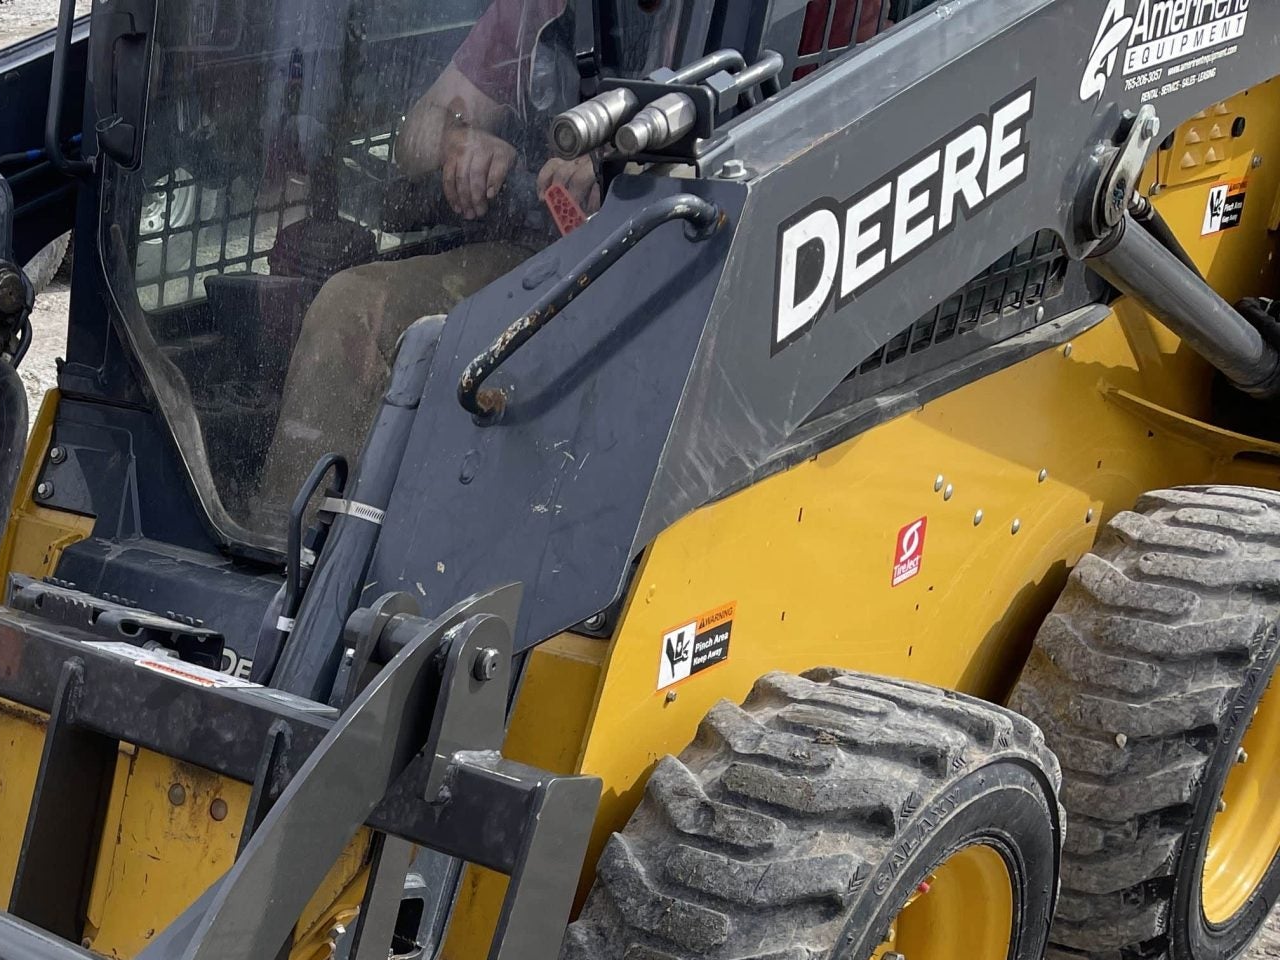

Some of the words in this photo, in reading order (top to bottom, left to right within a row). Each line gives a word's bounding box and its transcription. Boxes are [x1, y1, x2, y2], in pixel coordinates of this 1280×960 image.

[1127, 0, 1250, 47] AmeriRe
[1126, 16, 1244, 70] EQUIPMENT
[1160, 80, 1180, 96] SERVICE
[777, 91, 1032, 343] DEERE
[705, 607, 733, 626] WARNING
[693, 654, 708, 666] Keep
[707, 647, 723, 660] Away
[694, 637, 713, 653] Pinch
[713, 631, 729, 645] Area
[873, 786, 962, 896] GALAXY
